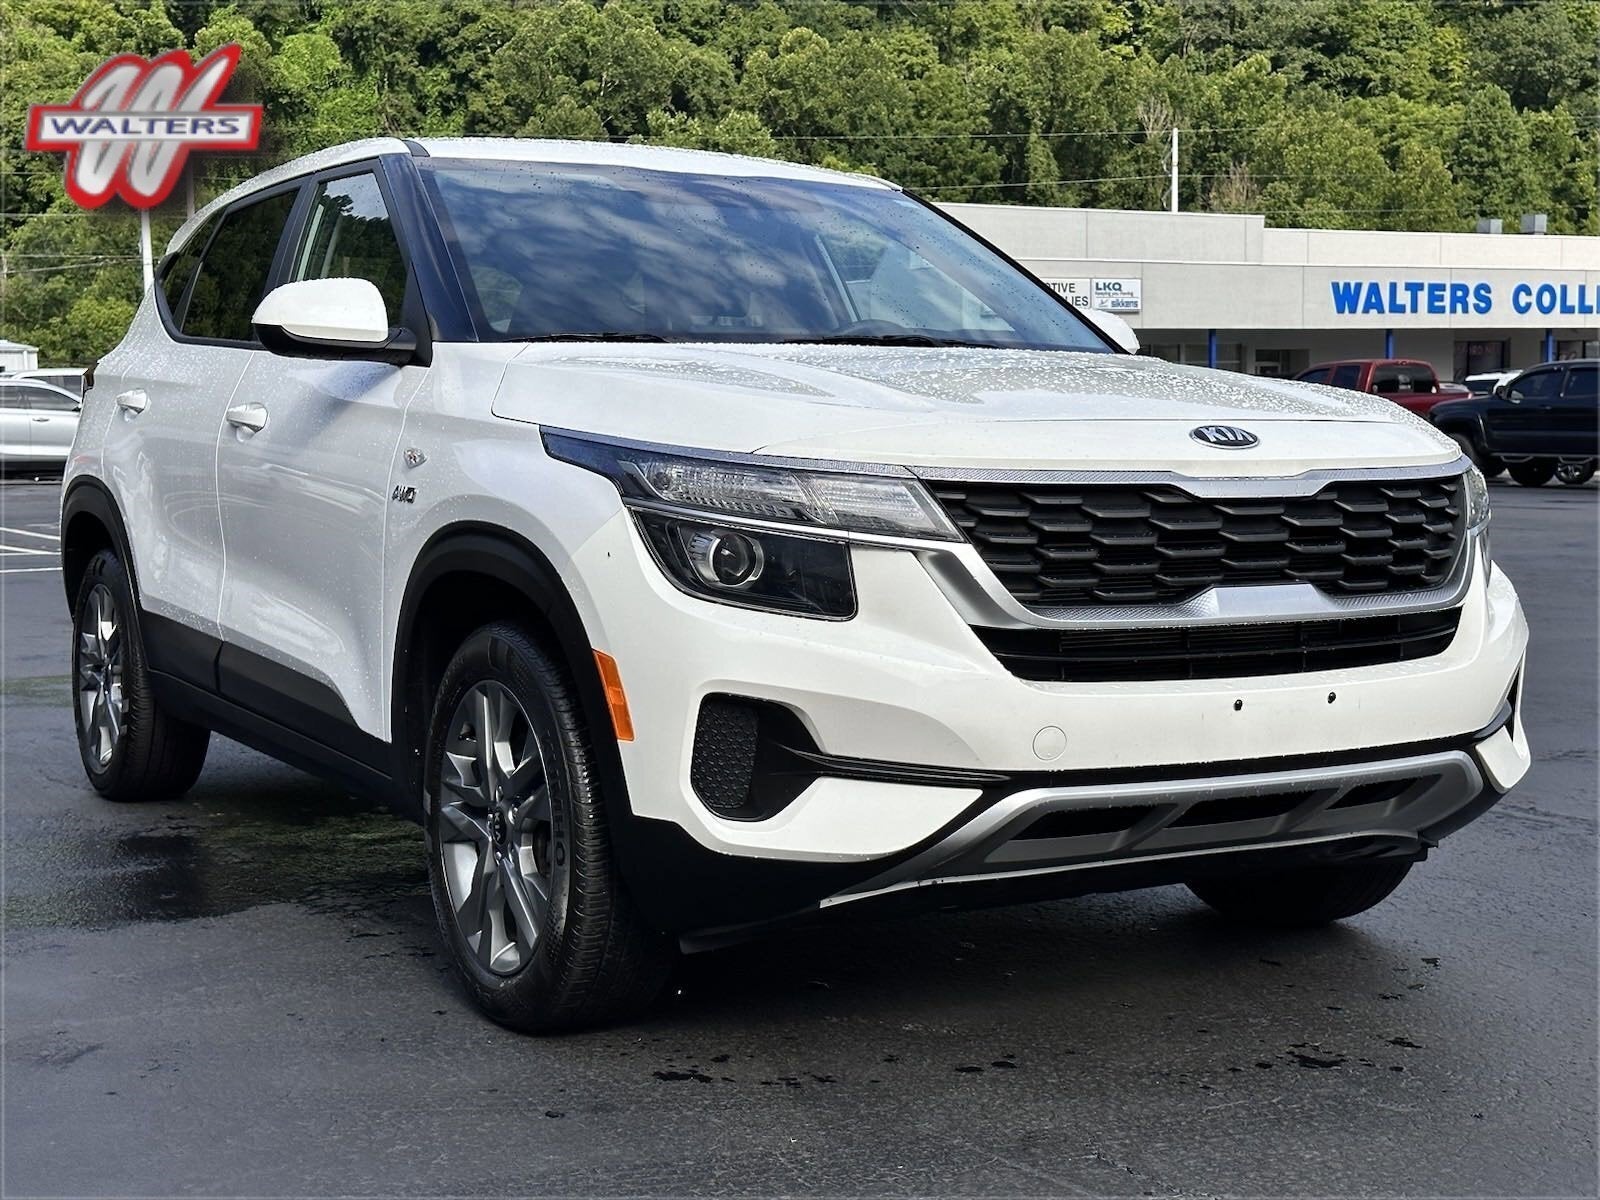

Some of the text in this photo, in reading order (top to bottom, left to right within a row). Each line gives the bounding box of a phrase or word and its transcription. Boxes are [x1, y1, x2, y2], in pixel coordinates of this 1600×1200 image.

[1096, 282, 1122, 291] LKQ
[1331, 282, 1492, 314] WALTERS
[1199, 427, 1255, 442] KIA
